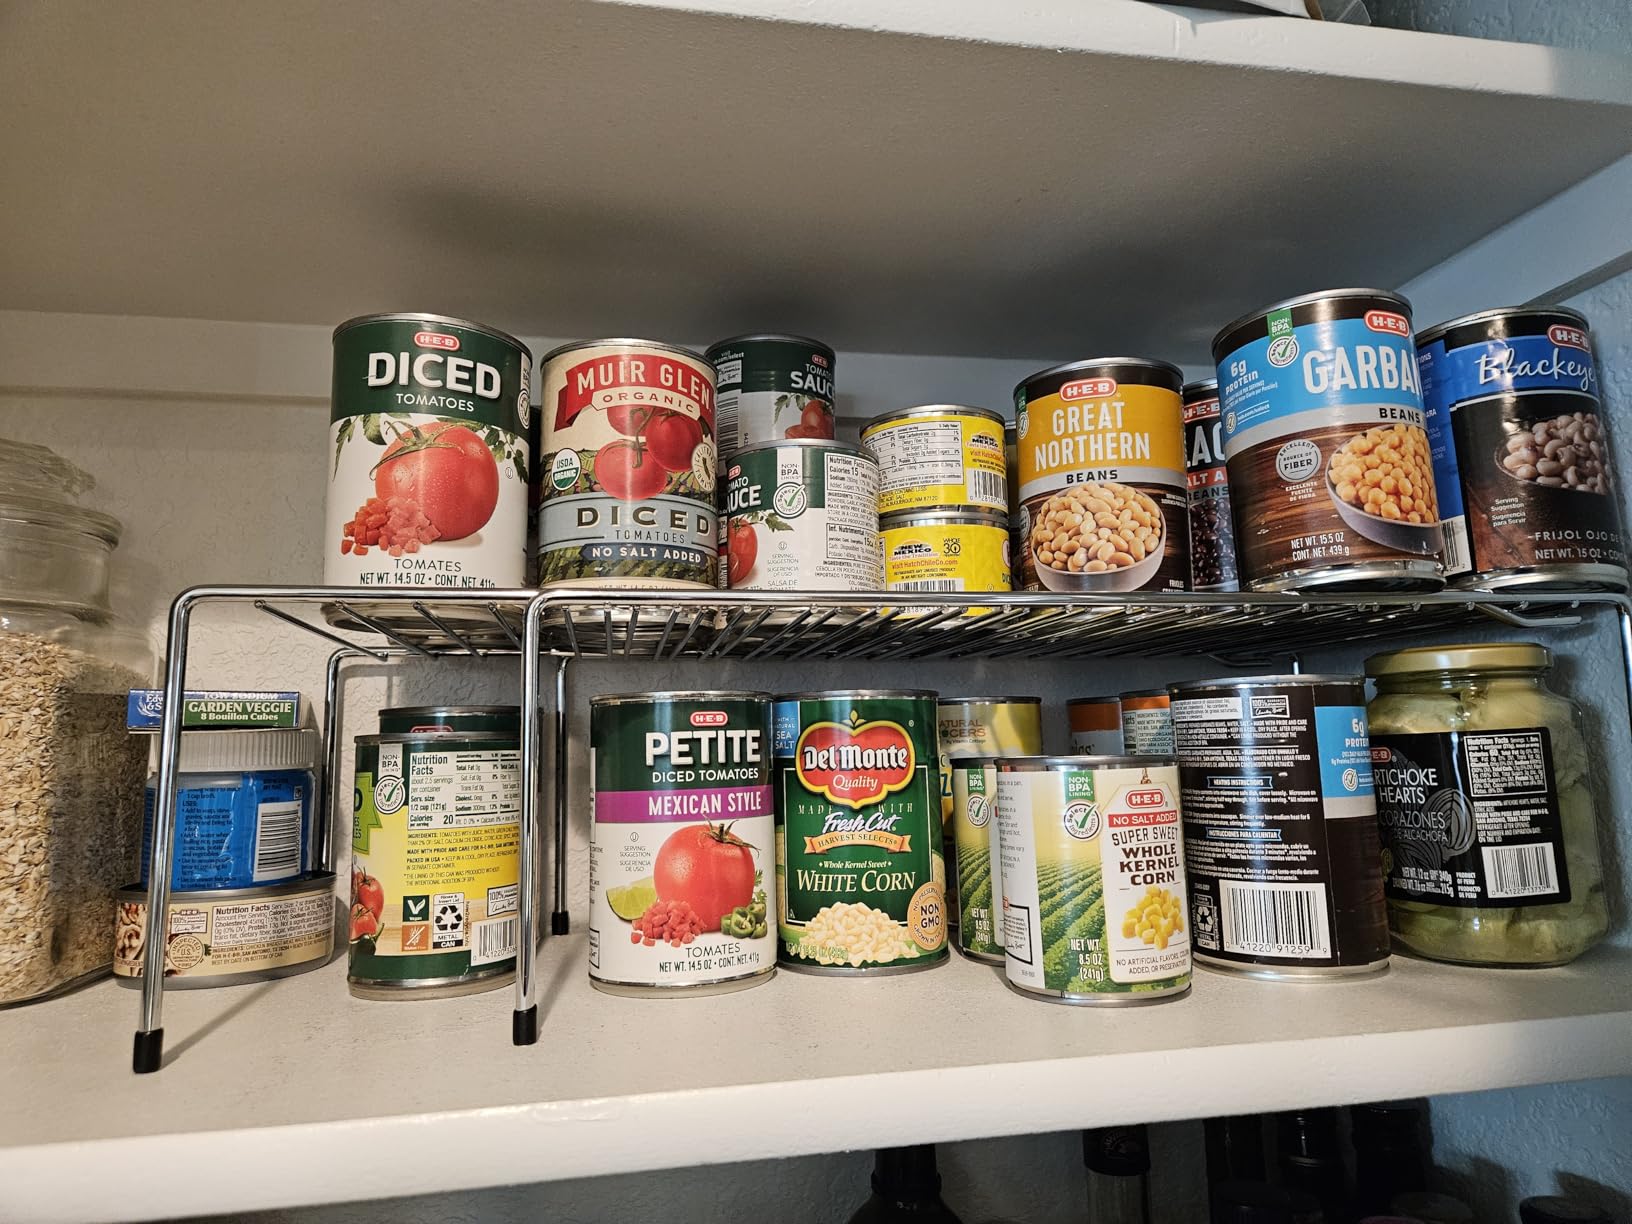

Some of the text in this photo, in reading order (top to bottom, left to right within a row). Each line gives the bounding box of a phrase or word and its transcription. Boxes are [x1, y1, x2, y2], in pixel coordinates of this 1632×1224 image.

[1272, 323, 1289, 332] BPA
[367, 352, 500, 399] DICED
[1231, 360, 1246, 377] 6g
[577, 360, 646, 396] MUIR
[790, 371, 834, 399] SAUC
[1225, 371, 1258, 395] PROTEIN
[396, 393, 474, 412] TOMATOES
[602, 392, 694, 413] ORGANIC
[1052, 401, 1125, 436] GREAT
[1380, 407, 1420, 424] BEANS
[1035, 432, 1150, 472] NORTHERN
[1279, 441, 1315, 456] EXCELLENT
[556, 457, 574, 470] USDA
[830, 457, 852, 465] Nutrition
[1284, 459, 1313, 470] FIBER
[554, 468, 577, 481] ORGANIC
[851, 467, 858, 476] 15
[1066, 469, 1119, 484] BEANS
[1491, 503, 1524, 511] Suggestion
[1495, 497, 1518, 505] Serving
[577, 506, 711, 536] DICED
[1492, 511, 1526, 520] Sugerencia
[616, 530, 686, 544] TOMATOES
[1291, 532, 1344, 549] NET WT. 15.5 OZ
[1535, 530, 1607, 541] FRIJOL OJO
[592, 547, 701, 563] NO SALT ADDED
[894, 548, 931, 556] MEXICO
[943, 543, 960, 553] 30
[1293, 545, 1349, 561] CONT. NET. 439 g
[1536, 549, 1553, 560] NET
[1557, 548, 1574, 558] WT.
[1578, 548, 1587, 558] 15
[1589, 548, 1601, 558] OZ
[394, 559, 461, 572] TOMATES
[360, 573, 459, 587] NET WT. 14.5 OZ CONT.
[188, 702, 291, 713] GARDEN VEGGIE
[1352, 718, 1364, 737] 6g
[777, 731, 792, 739] SEA
[645, 729, 761, 766] PETITE
[776, 741, 794, 749] SALT
[411, 755, 448, 765] Nutrition
[803, 744, 908, 769] Del Monte
[412, 765, 433, 775] Facts
[652, 768, 759, 783] DICED TOMATOES
[833, 774, 878, 791] Quality
[1374, 768, 1438, 787] RTICHOKE
[1069, 784, 1090, 792] BPA
[1379, 787, 1426, 804] HEARTS
[649, 791, 761, 816] MEXICAN STYLE
[798, 803, 913, 815] MADE WITH
[443, 815, 453, 824] 20
[1068, 807, 1086, 823] Select
[1113, 813, 1176, 825] NO SALT ADDED
[1379, 811, 1446, 829] CORAZONES
[822, 812, 864, 834] Fresh
[818, 834, 856, 848] HARVEST
[1112, 827, 1178, 846] SUPER SWEET
[1404, 829, 1448, 842] ALCACHOFA
[1122, 843, 1176, 859] WHOLE
[1120, 856, 1179, 872] KERNEL
[797, 869, 916, 892] WHITE CORN
[1130, 870, 1175, 885] CORN
[216, 907, 249, 915] Nutrition
[921, 903, 939, 916] NON
[971, 908, 979, 918] NET
[921, 916, 940, 928] GMO
[173, 938, 200, 951] INSPECTED
[685, 943, 741, 958] TOMATES
[1071, 939, 1101, 951] NET WT.
[1240, 943, 1310, 954] 41220 91259
[659, 962, 671, 973] NET
[674, 961, 687, 972] WT.
[688, 959, 702, 971] 14.5
[704, 958, 712, 969] OZ
[719, 956, 735, 968] CONT.
[737, 954, 748, 966] NET.
[1079, 954, 1102, 965] 8.5 OZ
[1128, 957, 1158, 965] ARTIFICIAL
[1080, 968, 1104, 982] (241g)
